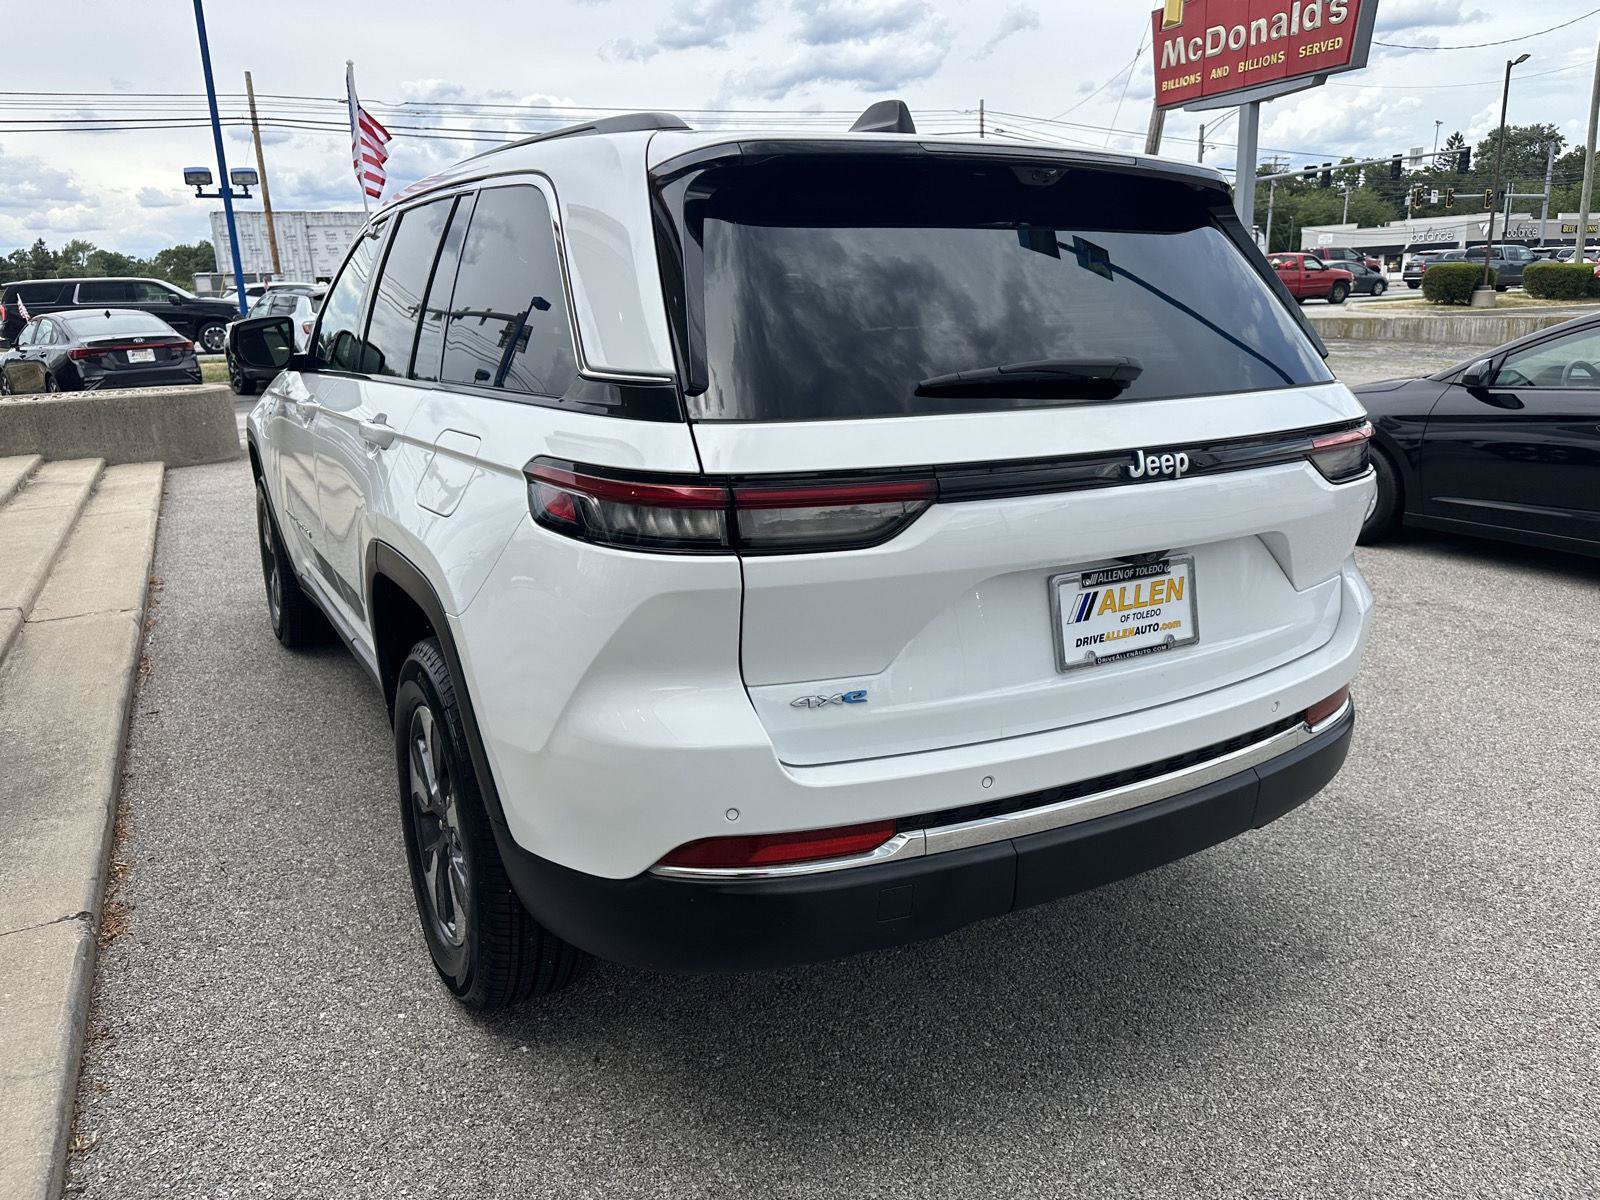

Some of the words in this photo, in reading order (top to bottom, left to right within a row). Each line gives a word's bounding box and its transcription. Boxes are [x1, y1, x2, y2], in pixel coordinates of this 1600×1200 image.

[1160, 0, 1348, 69] McDonalds
[1161, 72, 1201, 91] BILLIONS
[1210, 65, 1229, 80] AND
[1238, 51, 1286, 73] BILLIONS
[1298, 37, 1343, 58] SERVED
[1411, 227, 1454, 241] balance
[1128, 450, 1189, 478] Jeep
[1098, 569, 1123, 584] ALLEN
[1124, 569, 1134, 578] OF
[1135, 564, 1163, 576] TOLEDO
[1097, 576, 1185, 616] ALLEN
[1120, 614, 1130, 623] OF
[1132, 608, 1161, 620] TOLEDO
[1075, 620, 1182, 647] DRIVEALLENAUTO.com
